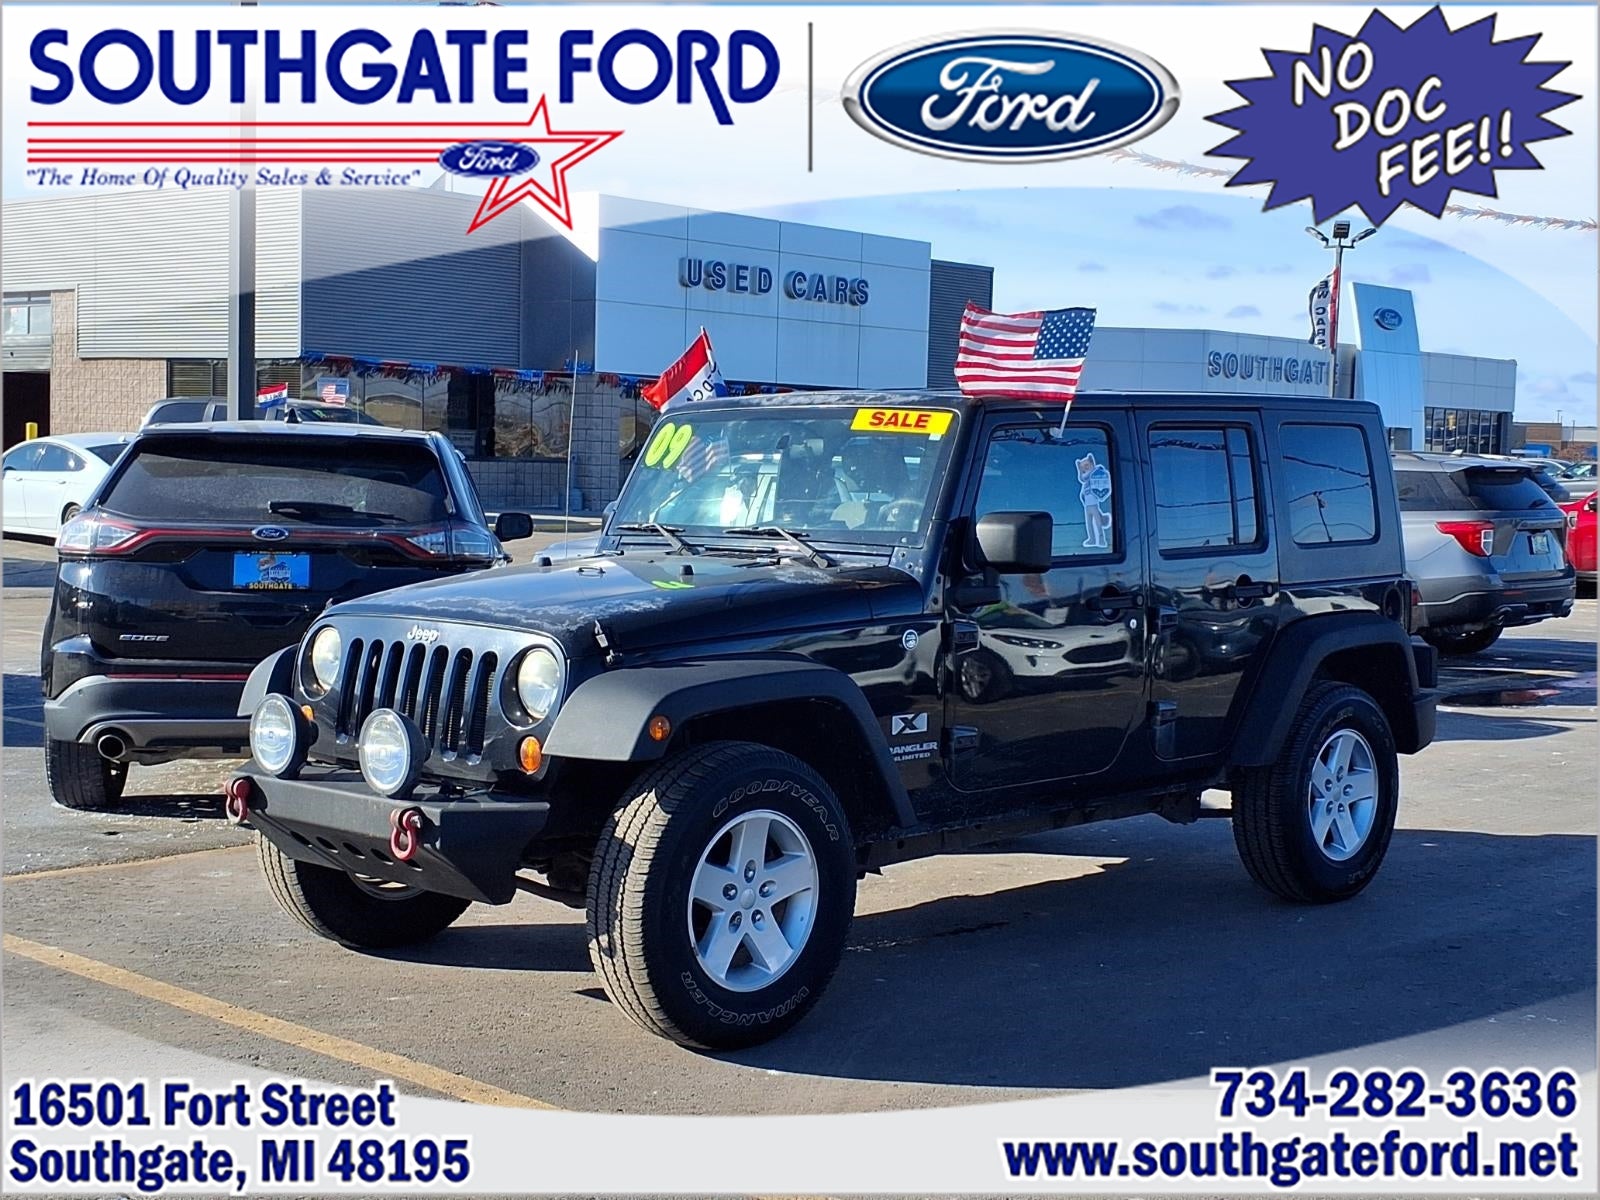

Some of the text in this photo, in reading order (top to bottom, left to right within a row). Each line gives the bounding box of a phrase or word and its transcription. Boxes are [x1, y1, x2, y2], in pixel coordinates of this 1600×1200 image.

[680, 257, 870, 305] USED CARS
[869, 411, 931, 428] SALE
[645, 422, 692, 469] 09
[260, 529, 280, 537] Ford
[249, 582, 293, 590] SOUTHGATE
[119, 634, 169, 642] EDGE
[407, 624, 439, 644] Jeep
[713, 779, 840, 842] GOODYEAR
[680, 970, 810, 1026] WRANGLER
